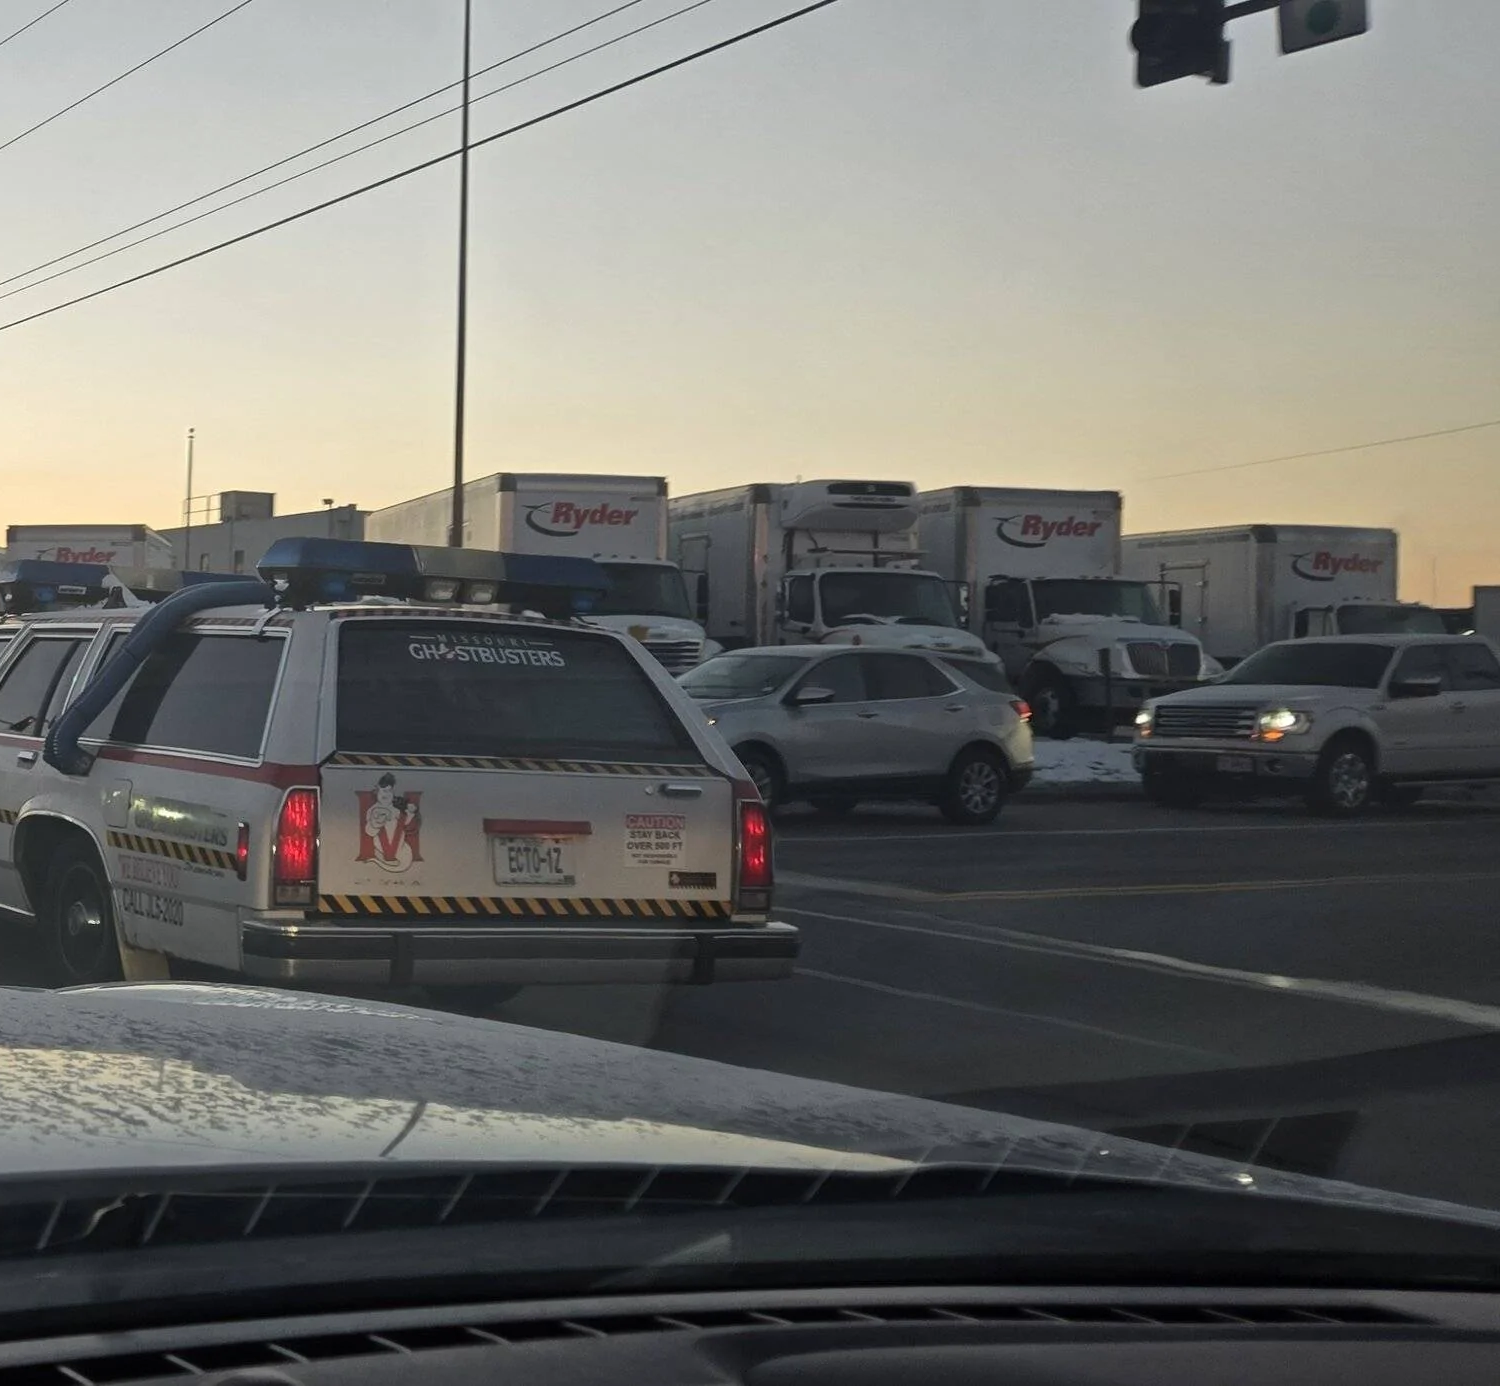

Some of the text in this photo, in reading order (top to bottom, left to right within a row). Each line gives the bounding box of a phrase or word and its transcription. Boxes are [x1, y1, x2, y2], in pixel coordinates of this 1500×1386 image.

[551, 502, 639, 529] Ryder
[1021, 515, 1103, 540] Ryder
[55, 547, 117, 564] Ryder
[1313, 551, 1384, 575] Ryder
[436, 634, 529, 648] MISSOURI
[628, 815, 685, 829] CAUTION
[629, 831, 681, 840] STAY BACK
